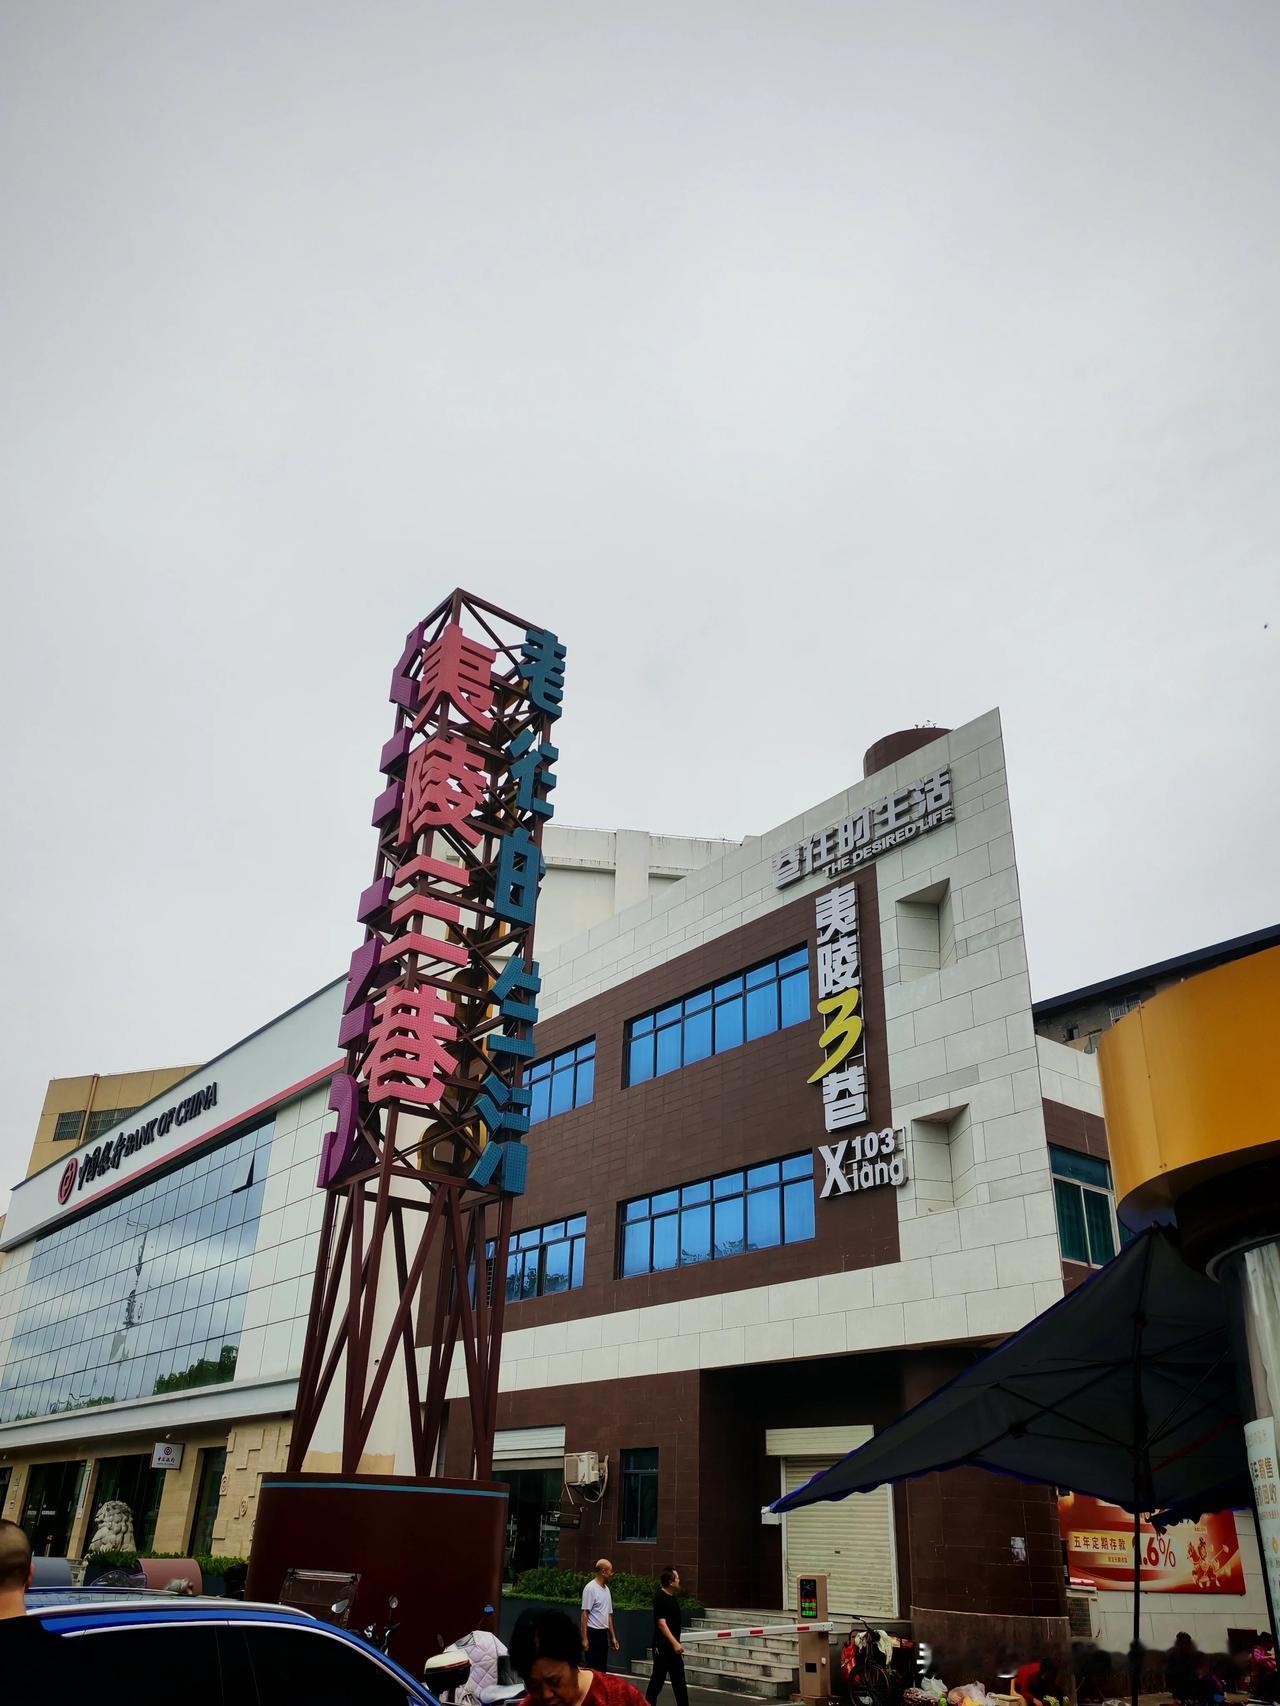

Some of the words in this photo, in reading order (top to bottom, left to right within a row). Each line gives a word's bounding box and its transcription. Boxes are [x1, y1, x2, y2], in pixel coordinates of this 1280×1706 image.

[822, 857, 851, 878] THE
[851, 823, 918, 866] DESIRED
[916, 805, 955, 834] LIFE
[123, 1117, 159, 1158] BANK
[156, 1107, 177, 1138] OF
[174, 1082, 218, 1127] CHINA
[851, 1127, 896, 1161] 103
[1073, 1535, 1127, 1551] 五年定期存款
